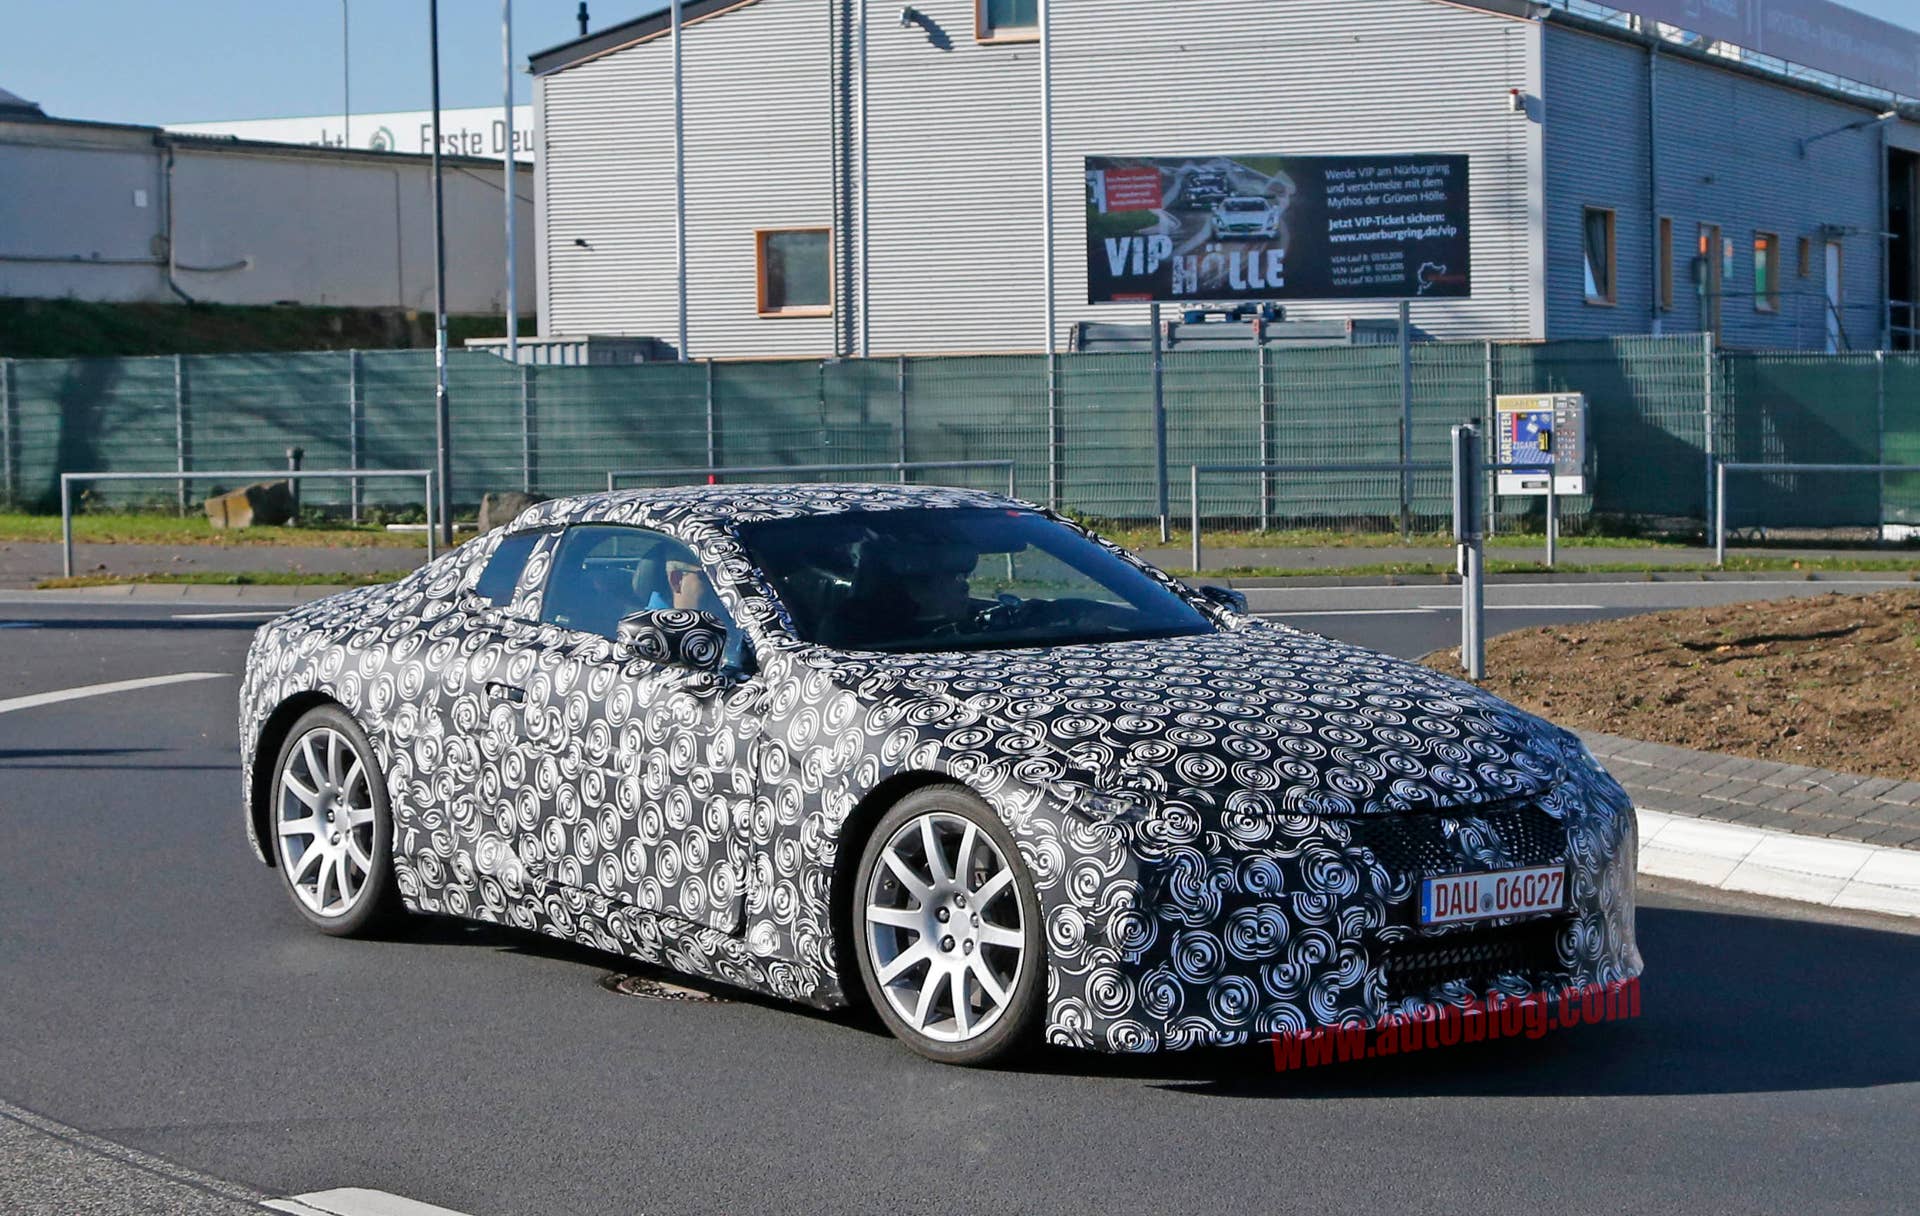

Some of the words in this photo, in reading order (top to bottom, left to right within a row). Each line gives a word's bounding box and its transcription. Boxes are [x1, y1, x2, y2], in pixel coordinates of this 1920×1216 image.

[1325, 169, 1356, 180] Werde
[1358, 167, 1374, 177] VIP
[1377, 168, 1391, 177] am
[1394, 164, 1450, 177] Nürburgring
[1327, 183, 1345, 194] und
[1405, 178, 1421, 189] mit
[1423, 177, 1443, 188] dem
[1327, 196, 1362, 209] Mythos
[1365, 194, 1381, 205] der
[1383, 192, 1418, 204] Grünen
[1420, 190, 1448, 201] Hölle.
[1329, 218, 1352, 231] Jetzt
[1354, 215, 1405, 227] VIP-Ticket
[1407, 212, 1445, 225] sichern:
[1329, 225, 1457, 243] www.nuerburgring.de/vip
[1105, 234, 1173, 277] VIP
[1172, 244, 1285, 295] HÖLLE
[1501, 412, 1512, 474] ZGARETTEN
[1435, 880, 1478, 918] DAU
[1496, 871, 1564, 911] 06027
